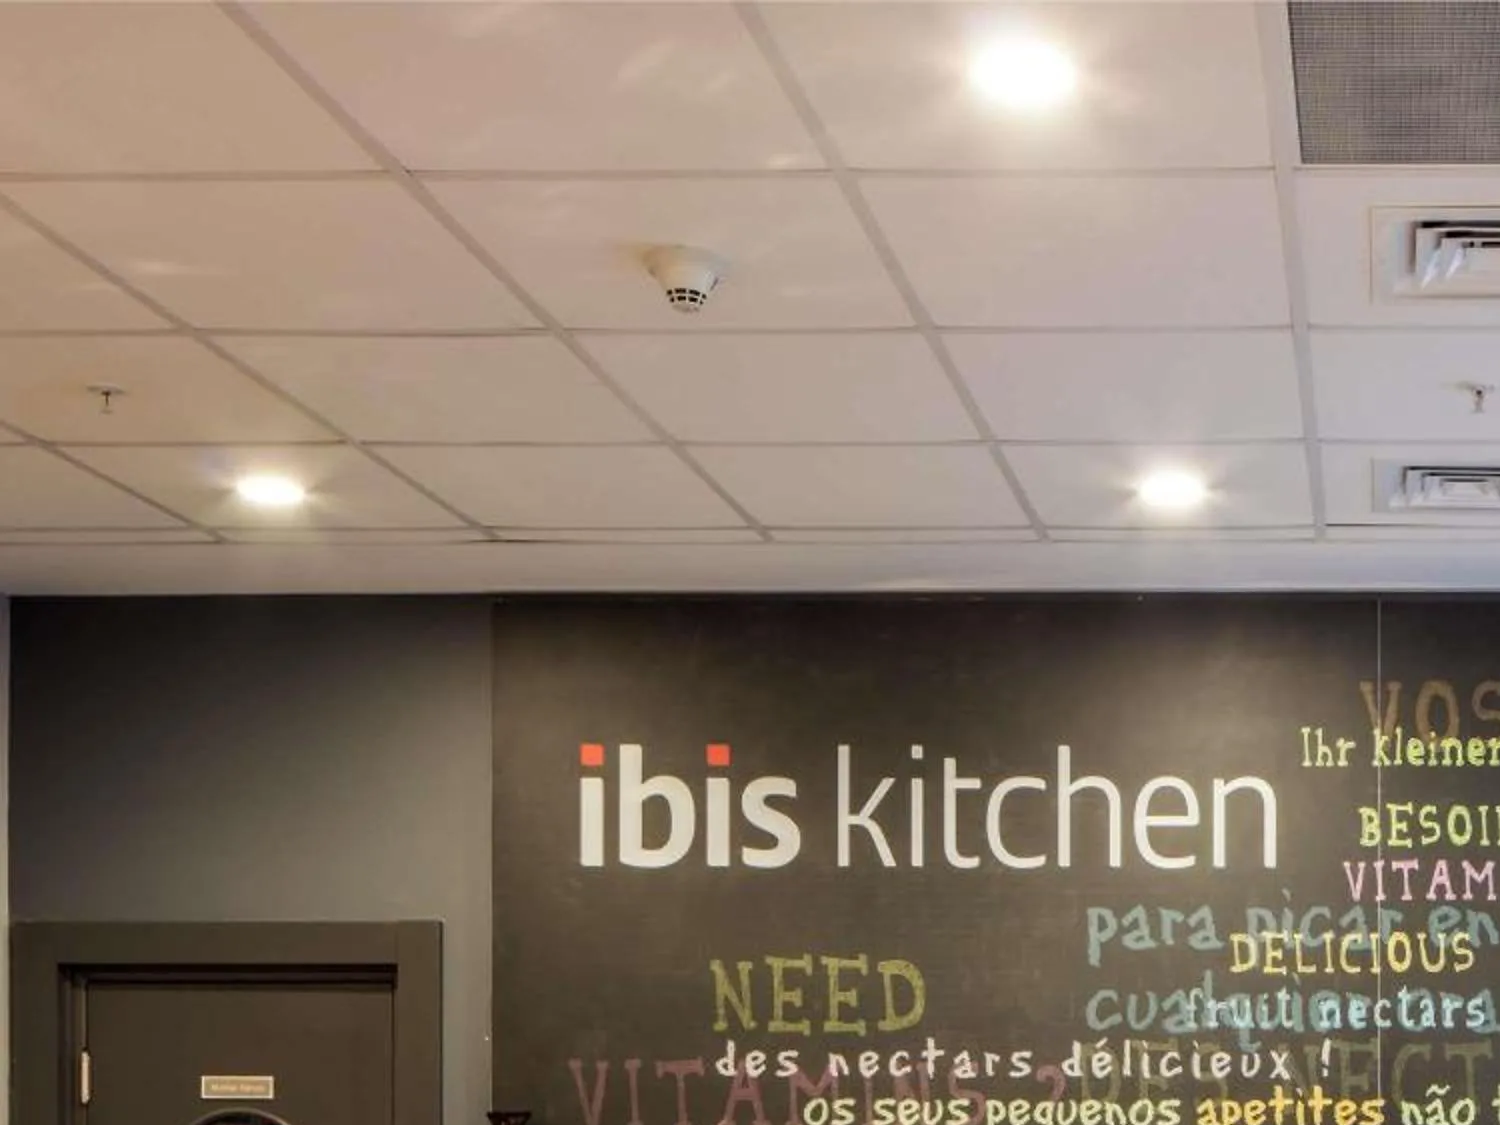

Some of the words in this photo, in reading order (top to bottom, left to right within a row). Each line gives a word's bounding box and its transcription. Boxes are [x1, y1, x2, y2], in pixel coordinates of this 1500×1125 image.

[1300, 727, 1356, 768] Ihr
[580, 744, 801, 868] ibis
[837, 745, 1277, 869] kitchen
[1087, 905, 1224, 967] para
[1246, 890, 1406, 955] picar
[1429, 905, 1499, 947] en
[1230, 932, 1475, 974] DELICIOUS
[709, 954, 925, 1036] NEED
[1318, 984, 1486, 1028] nectars
[715, 1040, 799, 1077] des
[828, 1037, 1032, 1080] nectars
[1062, 1038, 1291, 1080] délicieux
